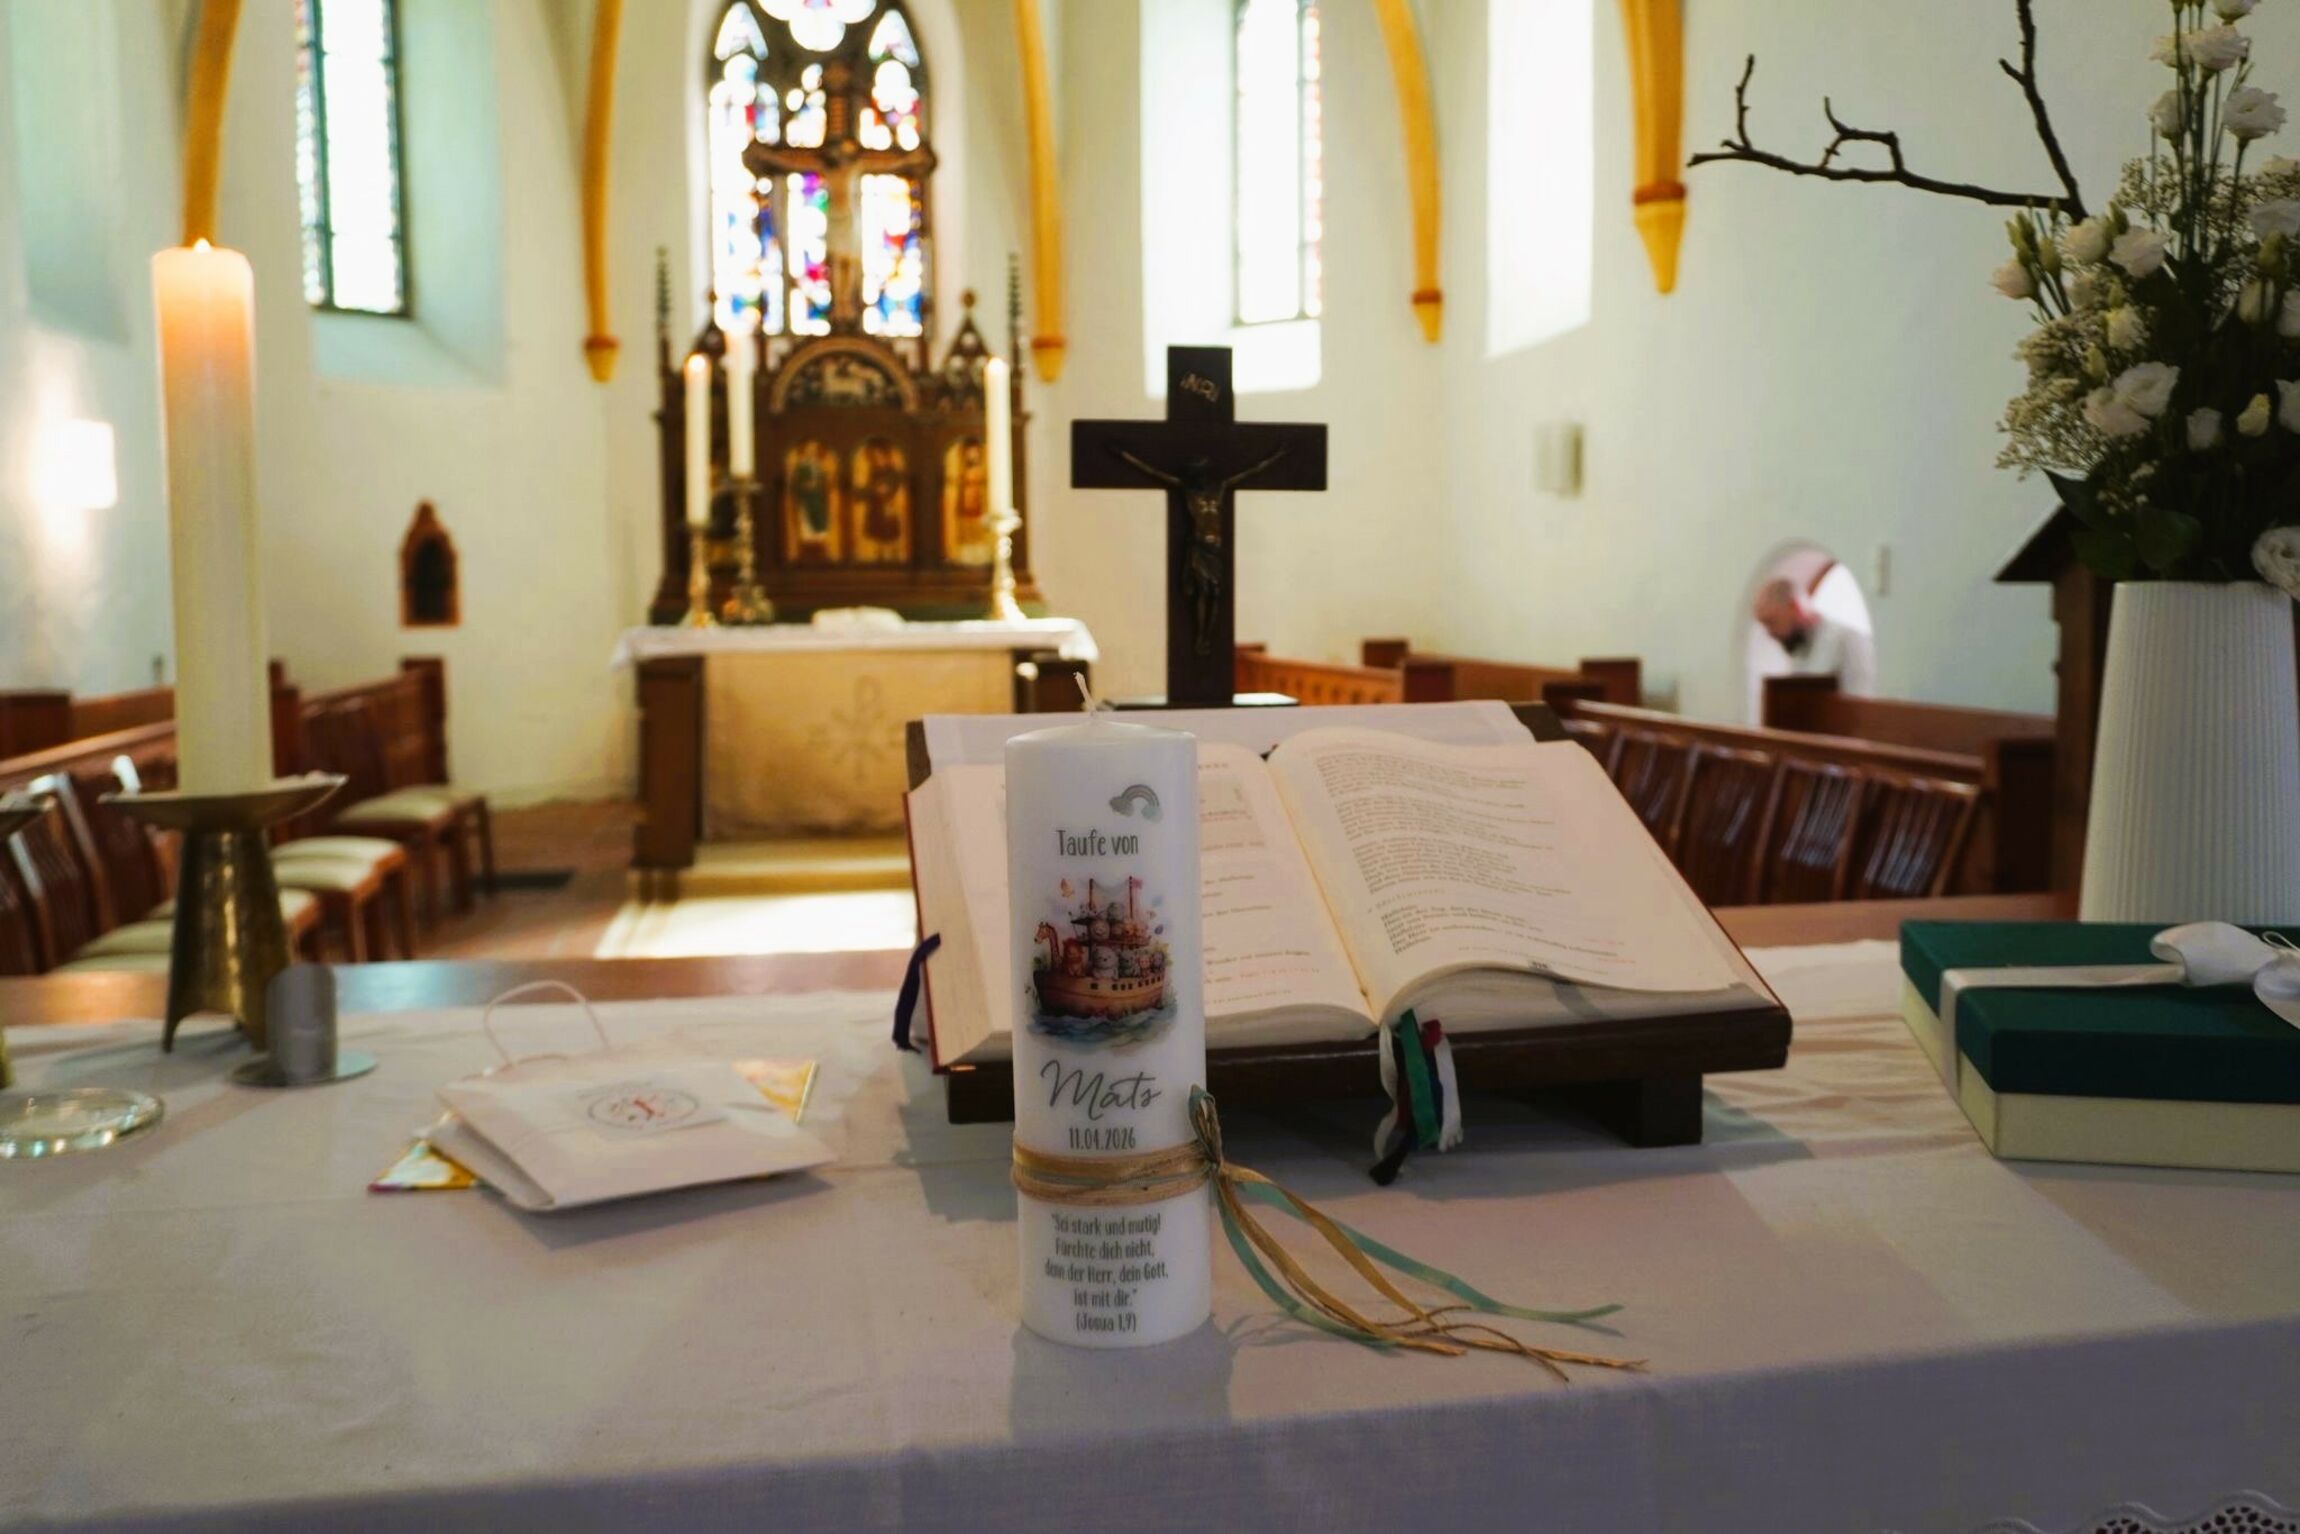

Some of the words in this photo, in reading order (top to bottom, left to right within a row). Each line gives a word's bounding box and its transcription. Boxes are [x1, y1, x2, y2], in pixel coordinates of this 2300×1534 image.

[1056, 829, 1106, 856] Taufe
[1111, 835, 1138, 855] von
[1040, 1060, 1162, 1120] Mats
[1069, 1127, 1136, 1150] 11.04.2026
[1071, 1216, 1101, 1235] stark
[1104, 1216, 1125, 1235] und
[1099, 1240, 1122, 1260] dich
[1067, 1263, 1085, 1281] der
[1119, 1265, 1141, 1283] dein
[1091, 1290, 1111, 1308] mit
